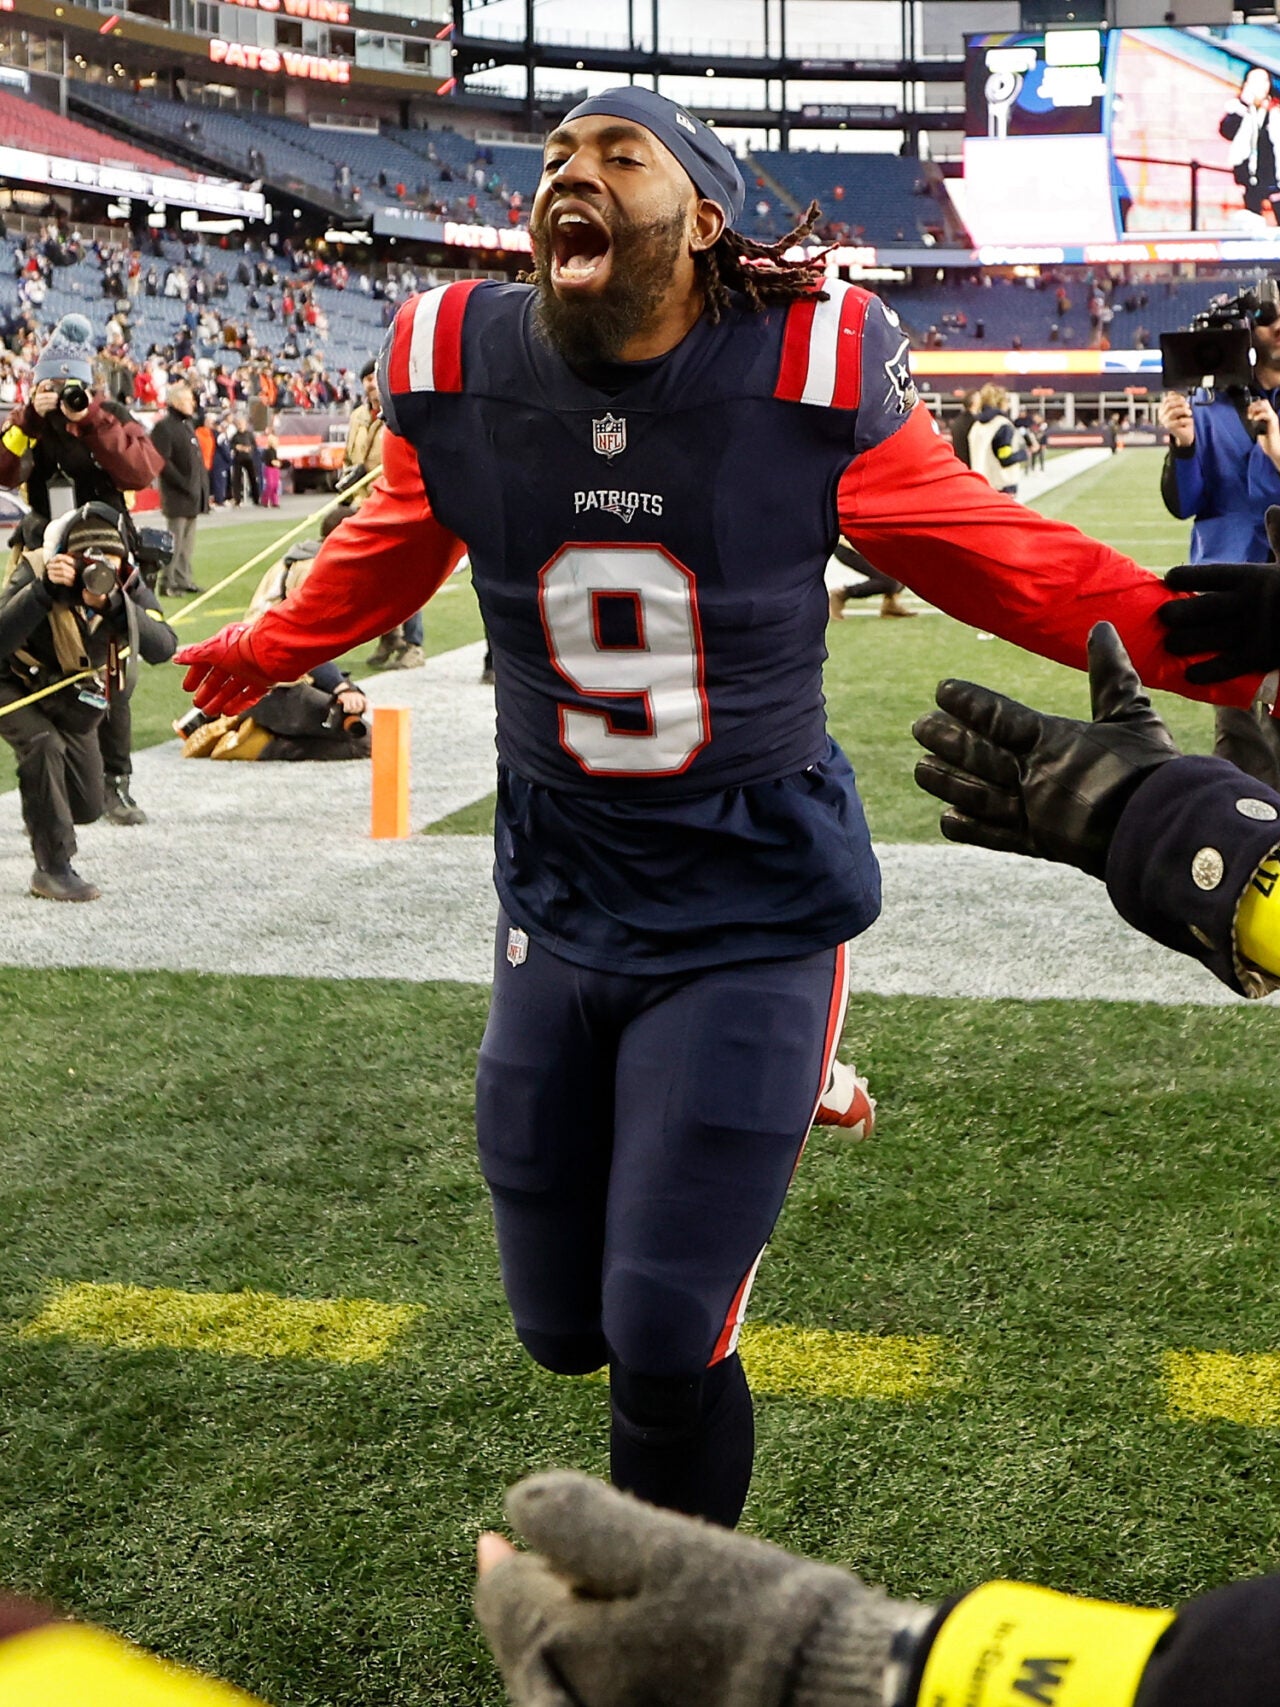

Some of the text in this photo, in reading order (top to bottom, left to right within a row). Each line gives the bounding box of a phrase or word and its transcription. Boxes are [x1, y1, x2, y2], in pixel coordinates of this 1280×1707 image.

[209, 39, 281, 72] PATS
[444, 221, 498, 249] PATS
[599, 434, 621, 451] NFL
[574, 490, 663, 516] PATRIOTS
[537, 541, 712, 778] 9
[1252, 867, 1280, 898] 17
